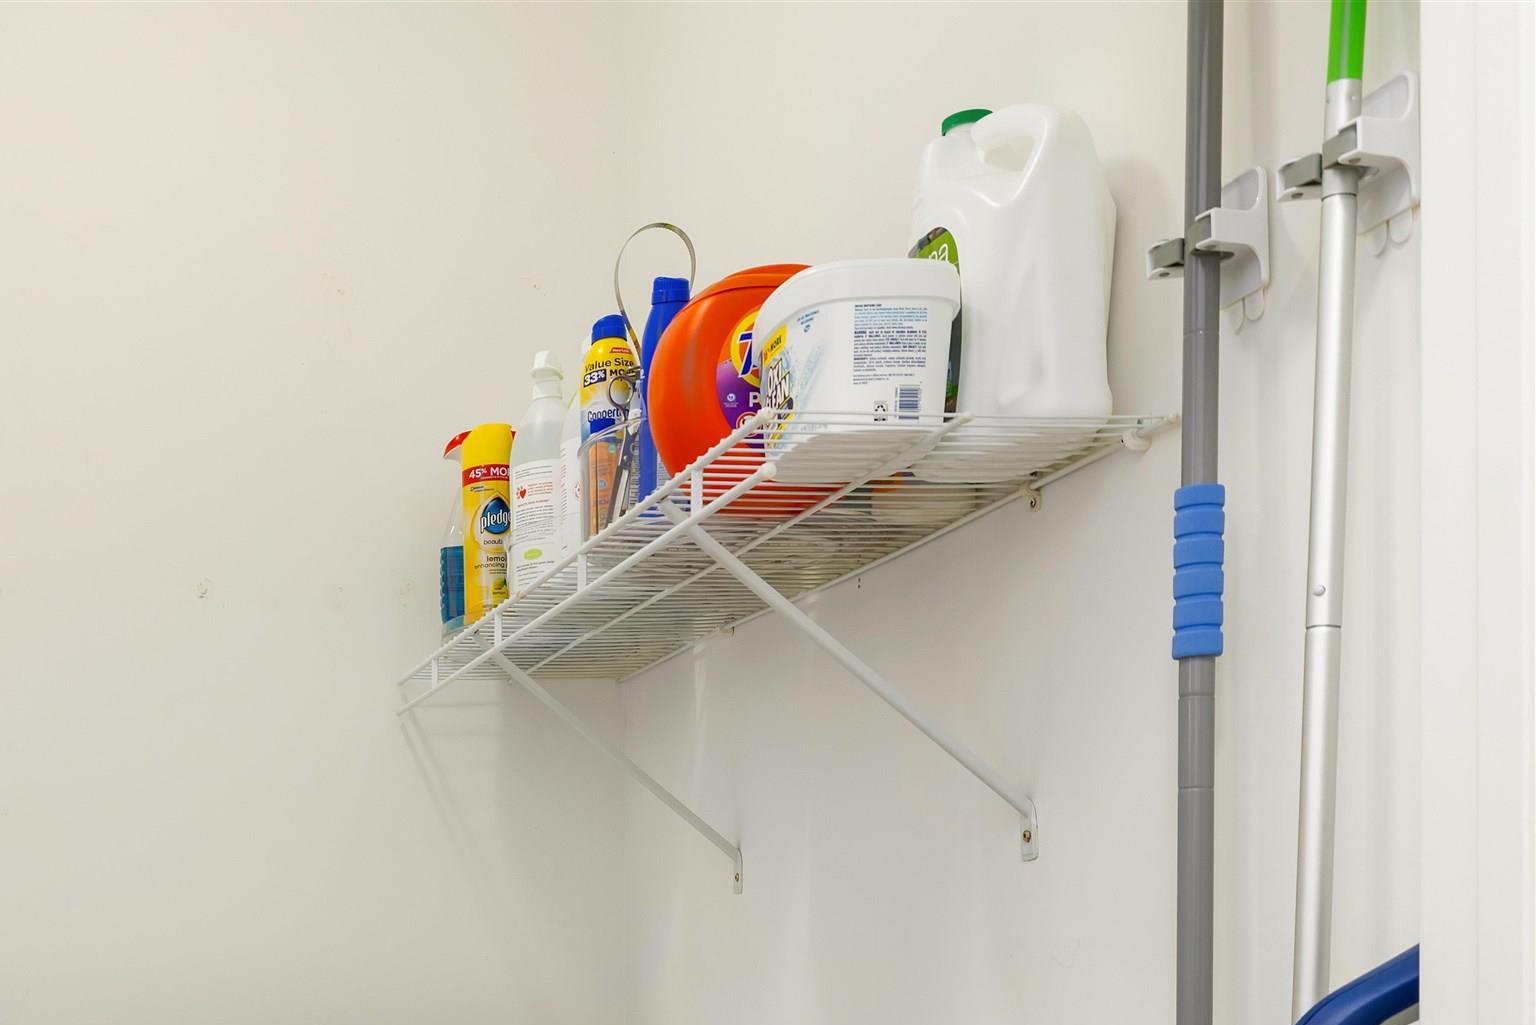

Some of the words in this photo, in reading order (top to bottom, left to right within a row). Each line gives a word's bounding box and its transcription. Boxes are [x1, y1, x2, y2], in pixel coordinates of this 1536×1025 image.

[585, 360, 612, 373] Value
[614, 357, 634, 367] Size
[584, 370, 606, 387] 33%
[767, 357, 782, 398] OXI
[469, 467, 488, 479] 45%
[490, 466, 511, 477] MO
[474, 562, 505, 570] enhancing
